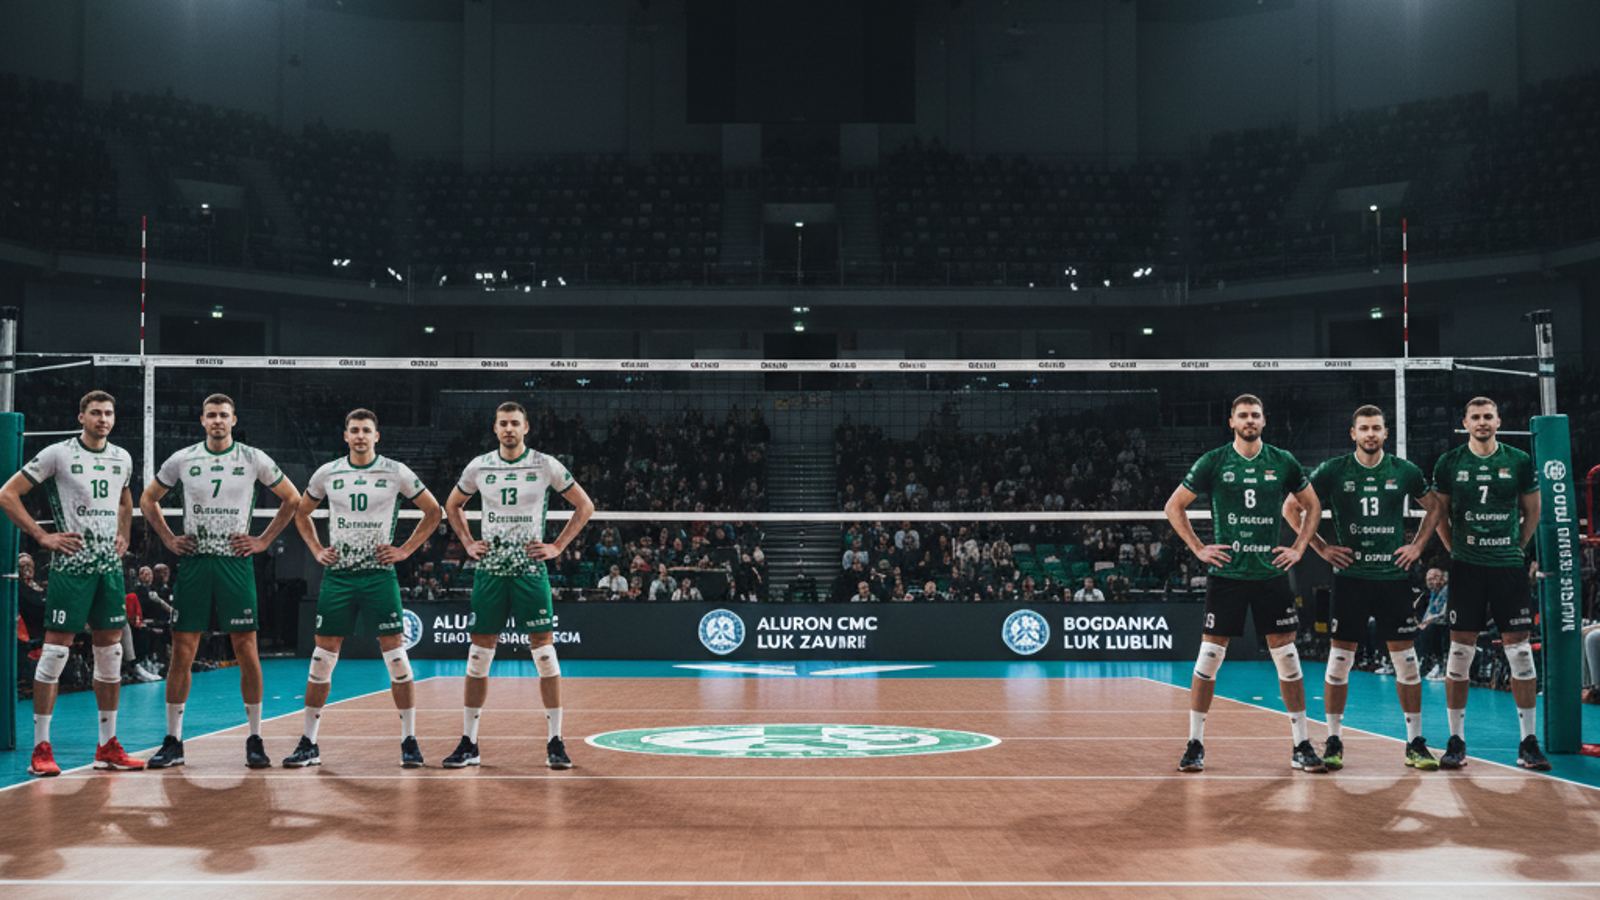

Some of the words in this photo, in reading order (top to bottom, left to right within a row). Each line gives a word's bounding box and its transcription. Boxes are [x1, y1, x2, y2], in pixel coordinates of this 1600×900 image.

[91, 479, 109, 499] 18
[211, 479, 222, 498] 7
[500, 487, 518, 505] 13
[1478, 485, 1489, 504] 7
[349, 493, 368, 512] 10
[1244, 488, 1256, 509] 8
[1360, 496, 1379, 516] 13
[756, 616, 832, 631] ALURON
[837, 616, 878, 631] CMC
[1063, 616, 1169, 631] BOGDANKA
[757, 635, 794, 649] LUK
[1064, 635, 1100, 649] LUK
[1106, 635, 1173, 650] LUBLIN
